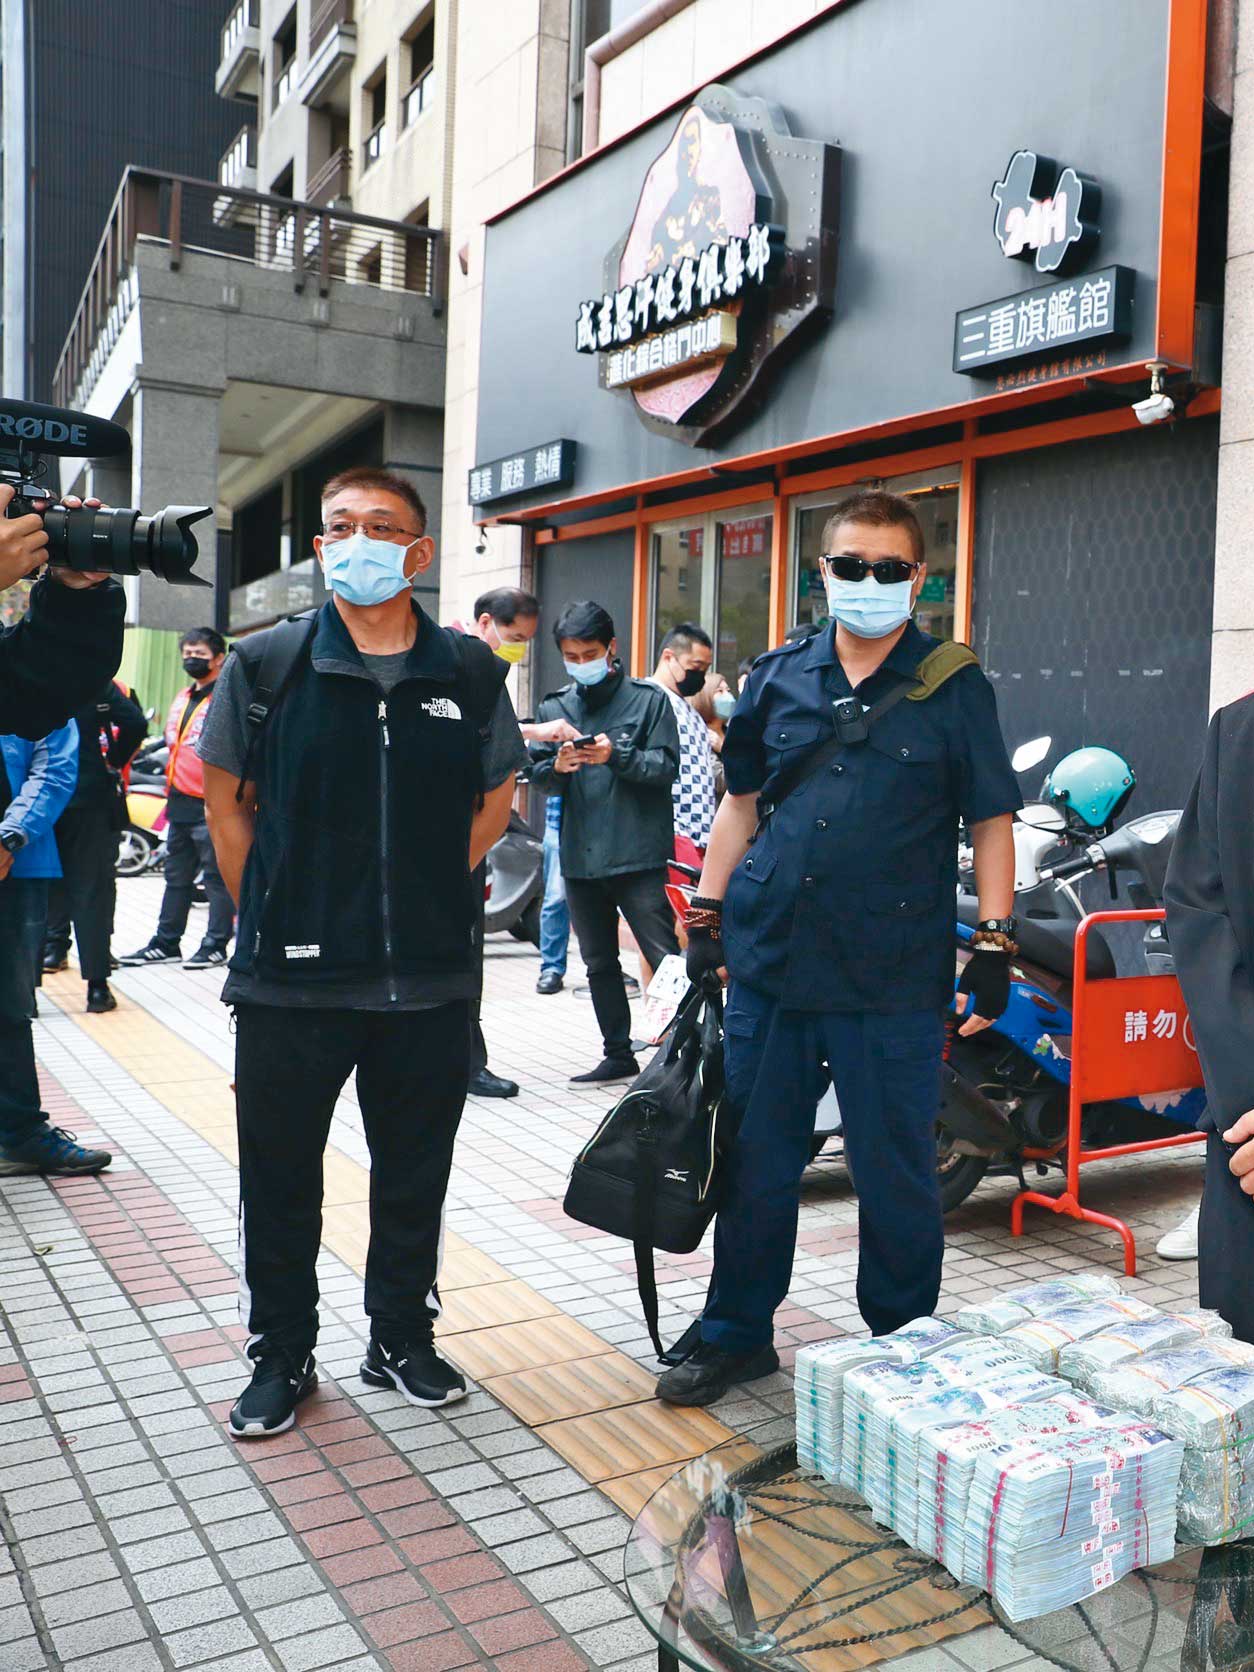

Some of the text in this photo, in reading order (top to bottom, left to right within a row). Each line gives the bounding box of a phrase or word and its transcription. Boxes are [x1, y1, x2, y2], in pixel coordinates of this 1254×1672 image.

[960, 277, 1111, 362] 三重旗艦館
[470, 445, 562, 501] 專業 服務 熱情
[421, 702, 448, 712] NORTH
[431, 697, 447, 706] THE
[429, 708, 448, 718] FACE
[1124, 1009, 1177, 1043] 請勿
